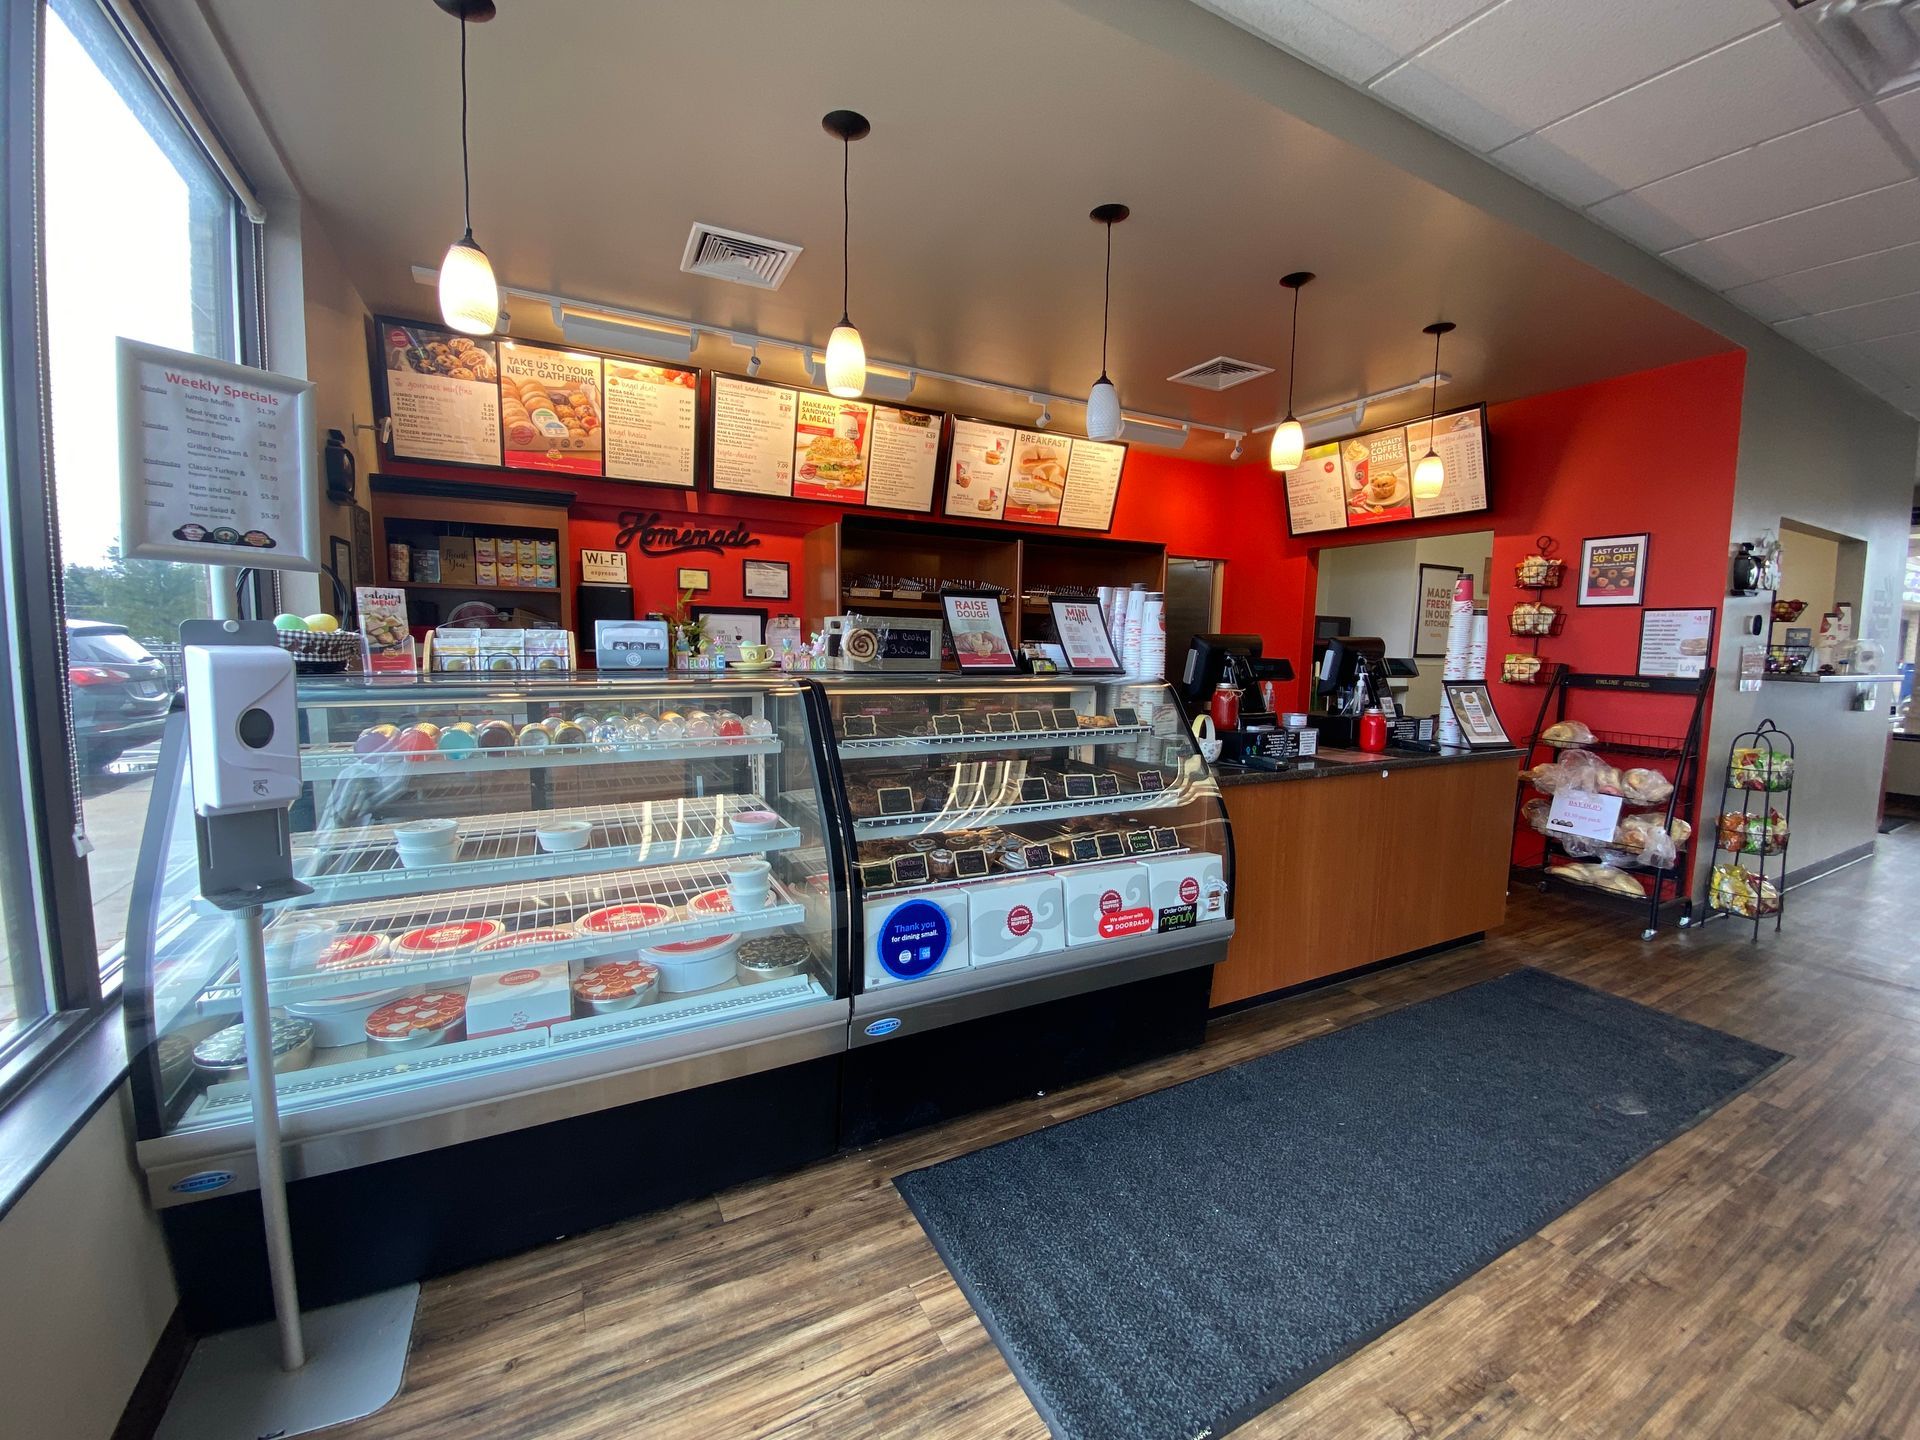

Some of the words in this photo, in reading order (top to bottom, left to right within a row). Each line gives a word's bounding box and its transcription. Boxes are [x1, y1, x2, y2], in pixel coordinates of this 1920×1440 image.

[508, 357, 533, 368] TAKE
[536, 361, 548, 370] US
[551, 364, 564, 372] TO
[567, 366, 594, 376] YOUR
[506, 366, 534, 376] NEXT
[538, 370, 596, 386] GATHERING
[165, 372, 220, 394] Weekly
[224, 385, 278, 406] Specials
[185, 393, 208, 402] Jumbo
[211, 398, 234, 408] Muffin
[204, 410, 217, 420] Veg
[220, 414, 232, 422] Out
[802, 408, 836, 417] SANDWICH
[809, 414, 834, 424] MEAL!
[212, 432, 234, 441] Bagels
[1020, 434, 1067, 448] BREAKFAST
[1370, 437, 1402, 448] SPECIALTY
[187, 442, 212, 452] Grilled
[214, 448, 241, 456] Chicken
[1371, 443, 1402, 456] COFFEE
[1372, 451, 1404, 463] DRINKS
[188, 463, 213, 472] Classic
[215, 468, 238, 476] Turkey
[616, 511, 760, 558] Homemade
[585, 552, 624, 566] Wi-Fi
[1593, 554, 1612, 563] 50%
[1613, 552, 1636, 562] OFF
[364, 590, 401, 604] catering
[1427, 588, 1452, 599] MADE
[955, 600, 988, 610] RAISE
[1426, 599, 1450, 609] FRESH
[1066, 608, 1088, 618] MINI
[1426, 610, 1433, 618] IN
[1434, 611, 1450, 620] OUR
[902, 632, 928, 642] Cookie
[678, 653, 726, 670] WELCOME
[894, 922, 920, 933] Thank
[921, 922, 936, 930] you
[1114, 918, 1150, 930] DOORDASH
[902, 933, 920, 941] dining
[921, 930, 938, 938] small.
[866, 1021, 900, 1032] FEDERAL
[172, 1174, 234, 1190] FEDERAL
